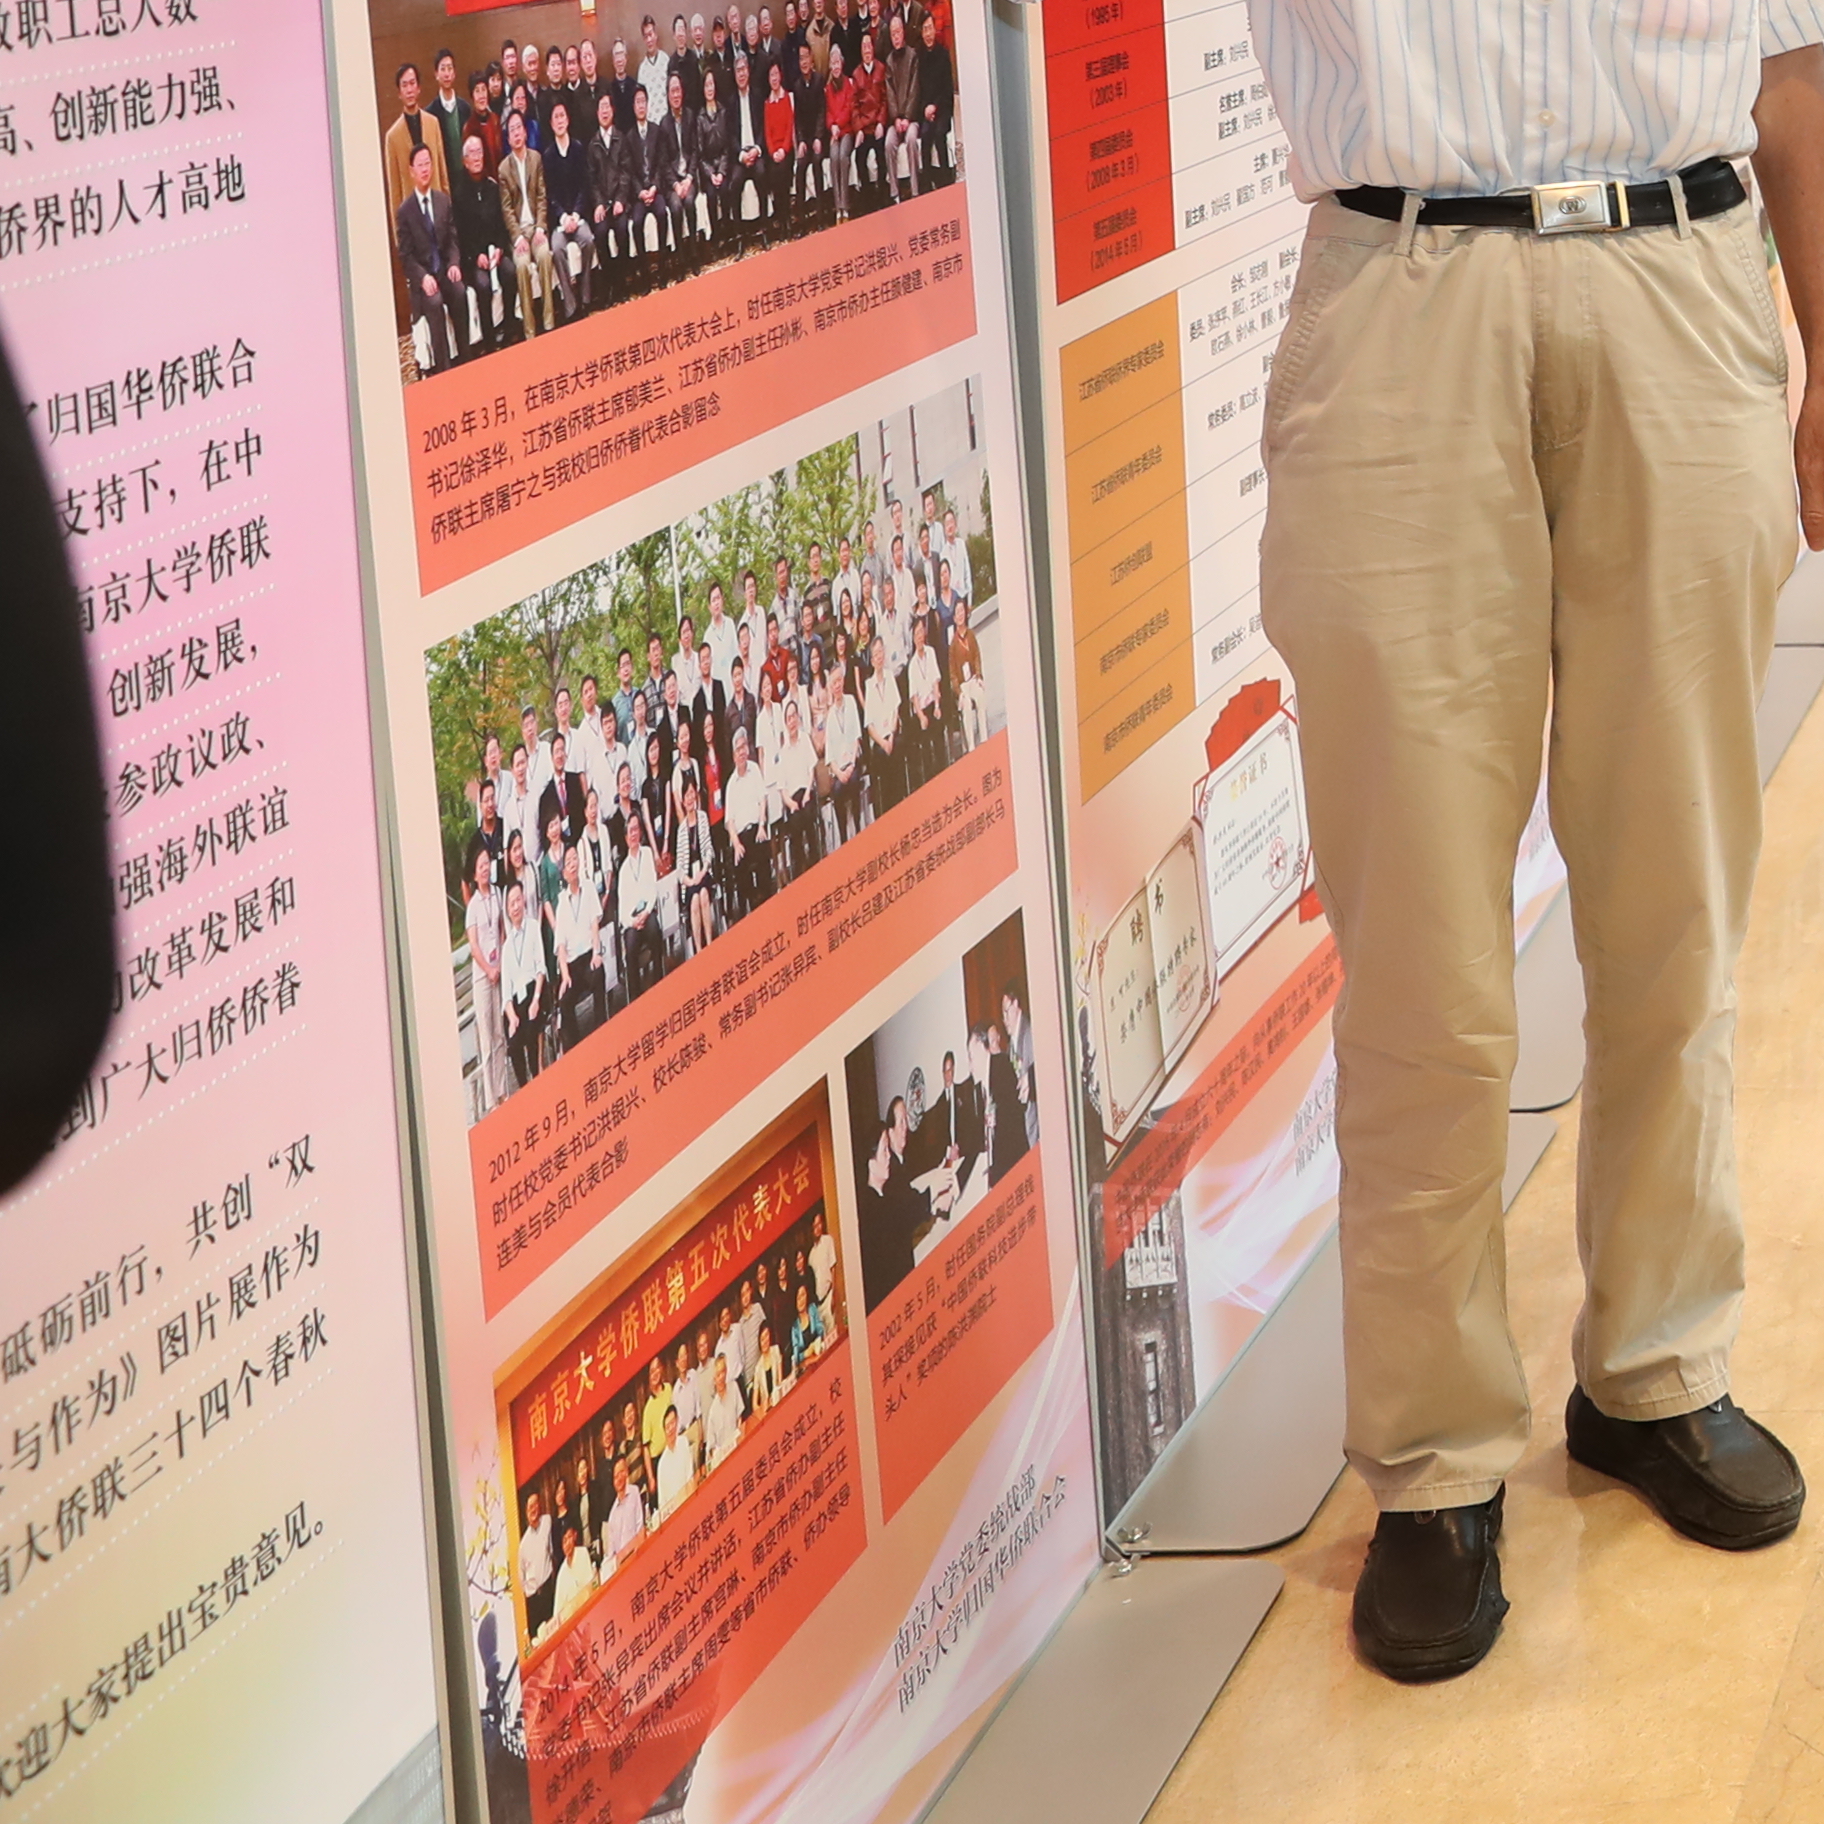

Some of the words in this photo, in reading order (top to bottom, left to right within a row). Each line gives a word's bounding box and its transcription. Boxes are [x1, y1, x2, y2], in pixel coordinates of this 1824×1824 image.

[20, 335, 257, 446] 归国华侨联合
[104, 711, 266, 821] 参政议政、
[113, 875, 296, 1014] 改革发展和
[58, 961, 303, 1142] 到广大归侨侨眷
[0, 1223, 321, 1485] 与作为》图片展作为
